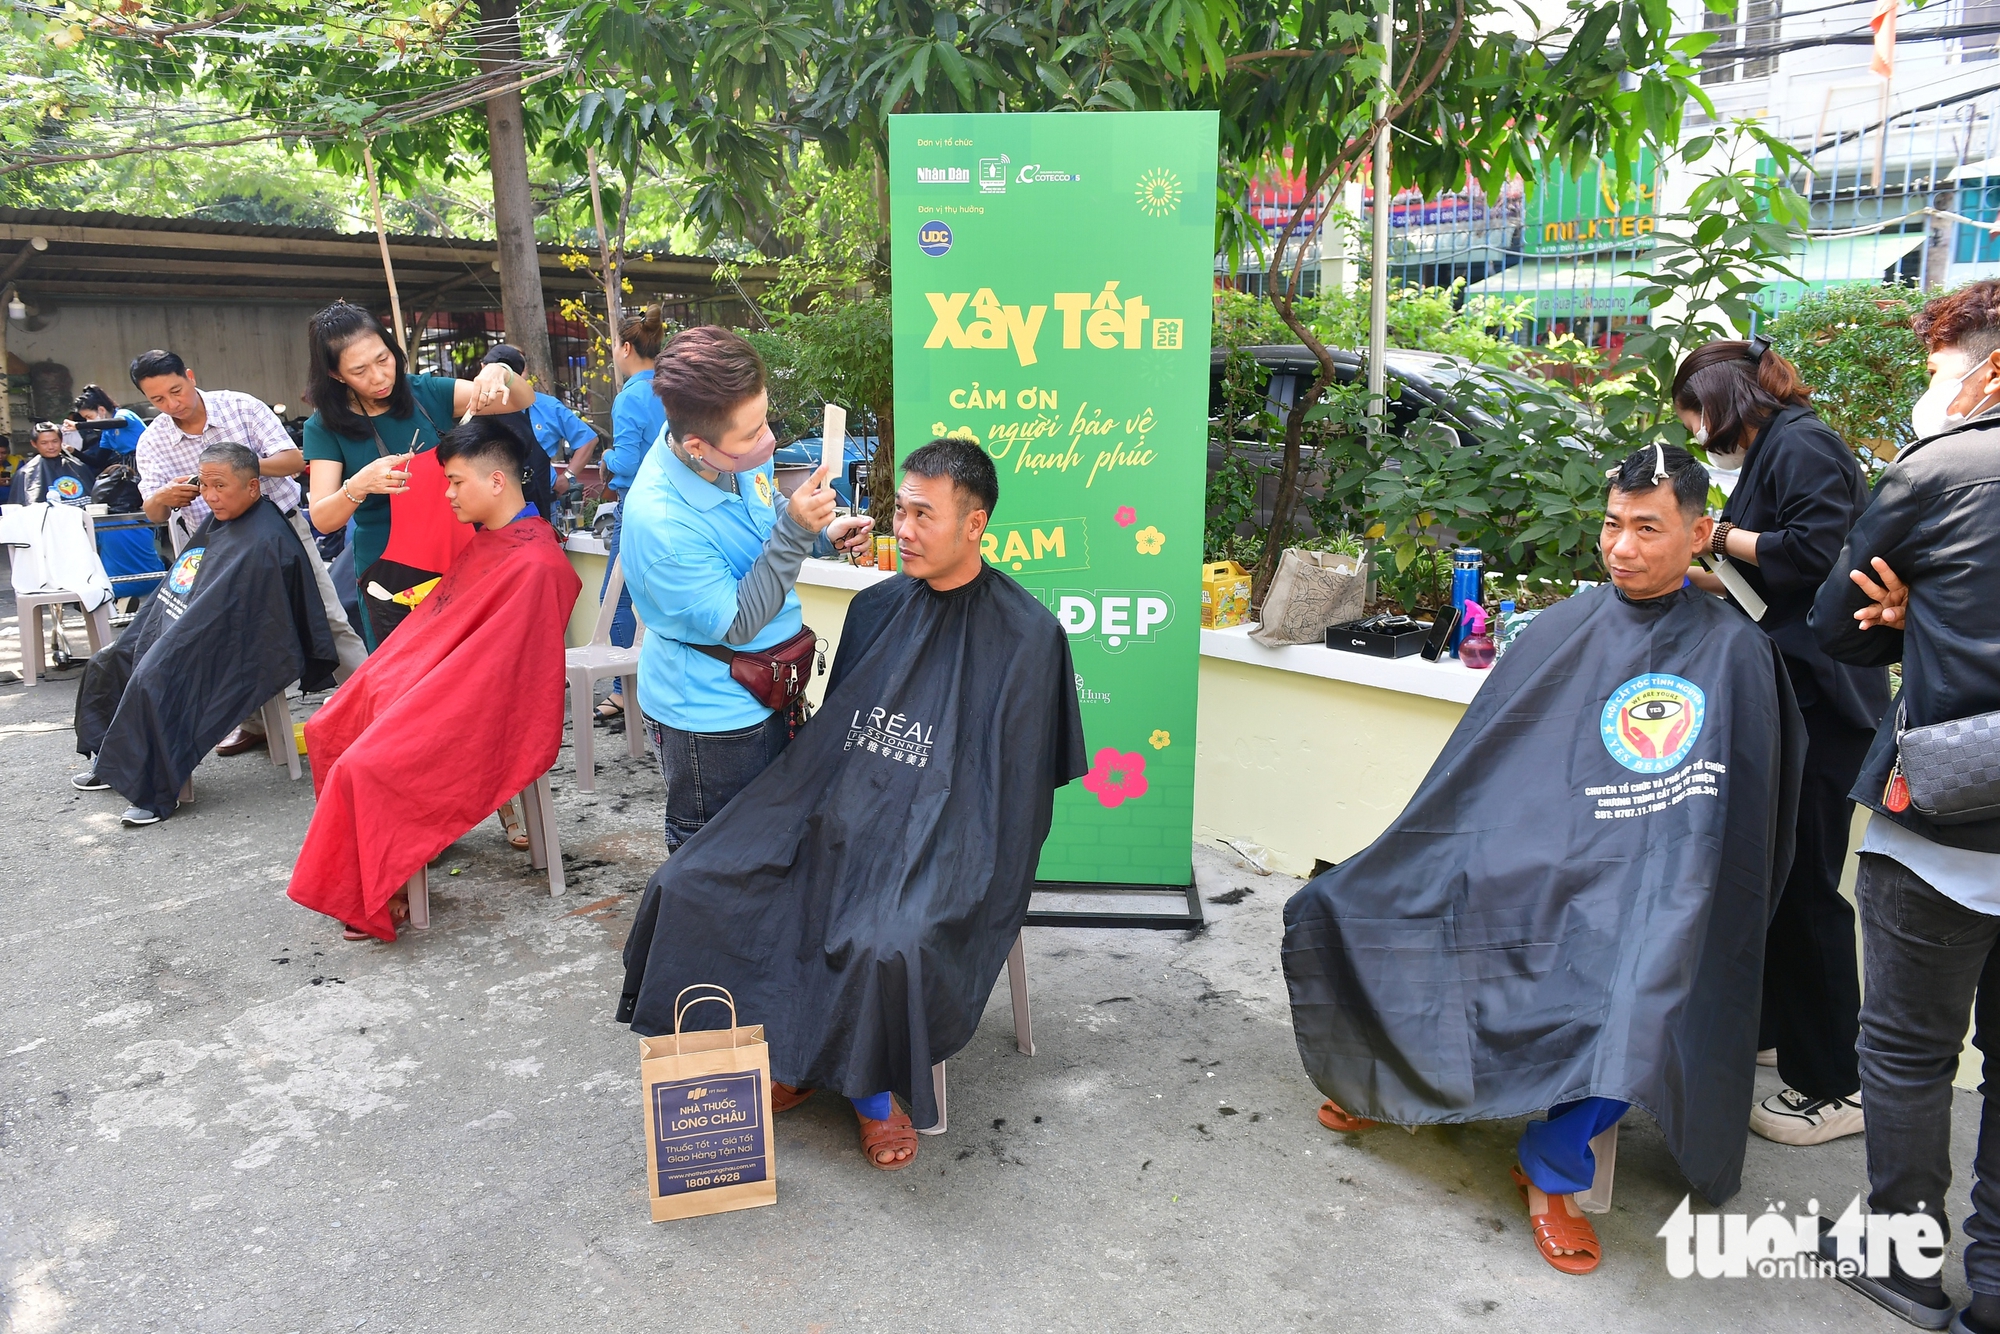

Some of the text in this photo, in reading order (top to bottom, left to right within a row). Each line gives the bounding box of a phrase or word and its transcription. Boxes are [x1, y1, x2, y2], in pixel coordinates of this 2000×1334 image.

[917, 137, 974, 148] Đơn vị tổ chức
[917, 166, 970, 181] Nhân Dân
[936, 206, 943, 214] vị
[944, 206, 958, 214] thụ
[960, 204, 984, 214] hưởng
[921, 230, 949, 243] UDC
[923, 287, 1048, 367] Xây
[1054, 280, 1150, 350] Tết
[949, 381, 1058, 410] CẢM ƠN
[988, 402, 1158, 460] người bảo vệ
[1014, 433, 1158, 489] hạnh phúc
[980, 526, 1066, 571] RẠM
[1057, 596, 1168, 647] ĐẸP
[1651, 678, 1674, 687] TÌNH
[1642, 691, 1655, 699] ARE
[1649, 706, 1662, 714] YES
[1608, 722, 1704, 771] YES BEAUTIFUL
[1652, 777, 1664, 788] VÀ
[679, 1098, 737, 1116] NHÀ THUỐC
[671, 1110, 747, 1132] LONG CHÂU
[665, 1133, 754, 1154] Thuốc Tốt Giá Tốt
[668, 1144, 753, 1164] Giao Hàng Tận Nơi
[685, 1172, 740, 1189] 1800 6928
